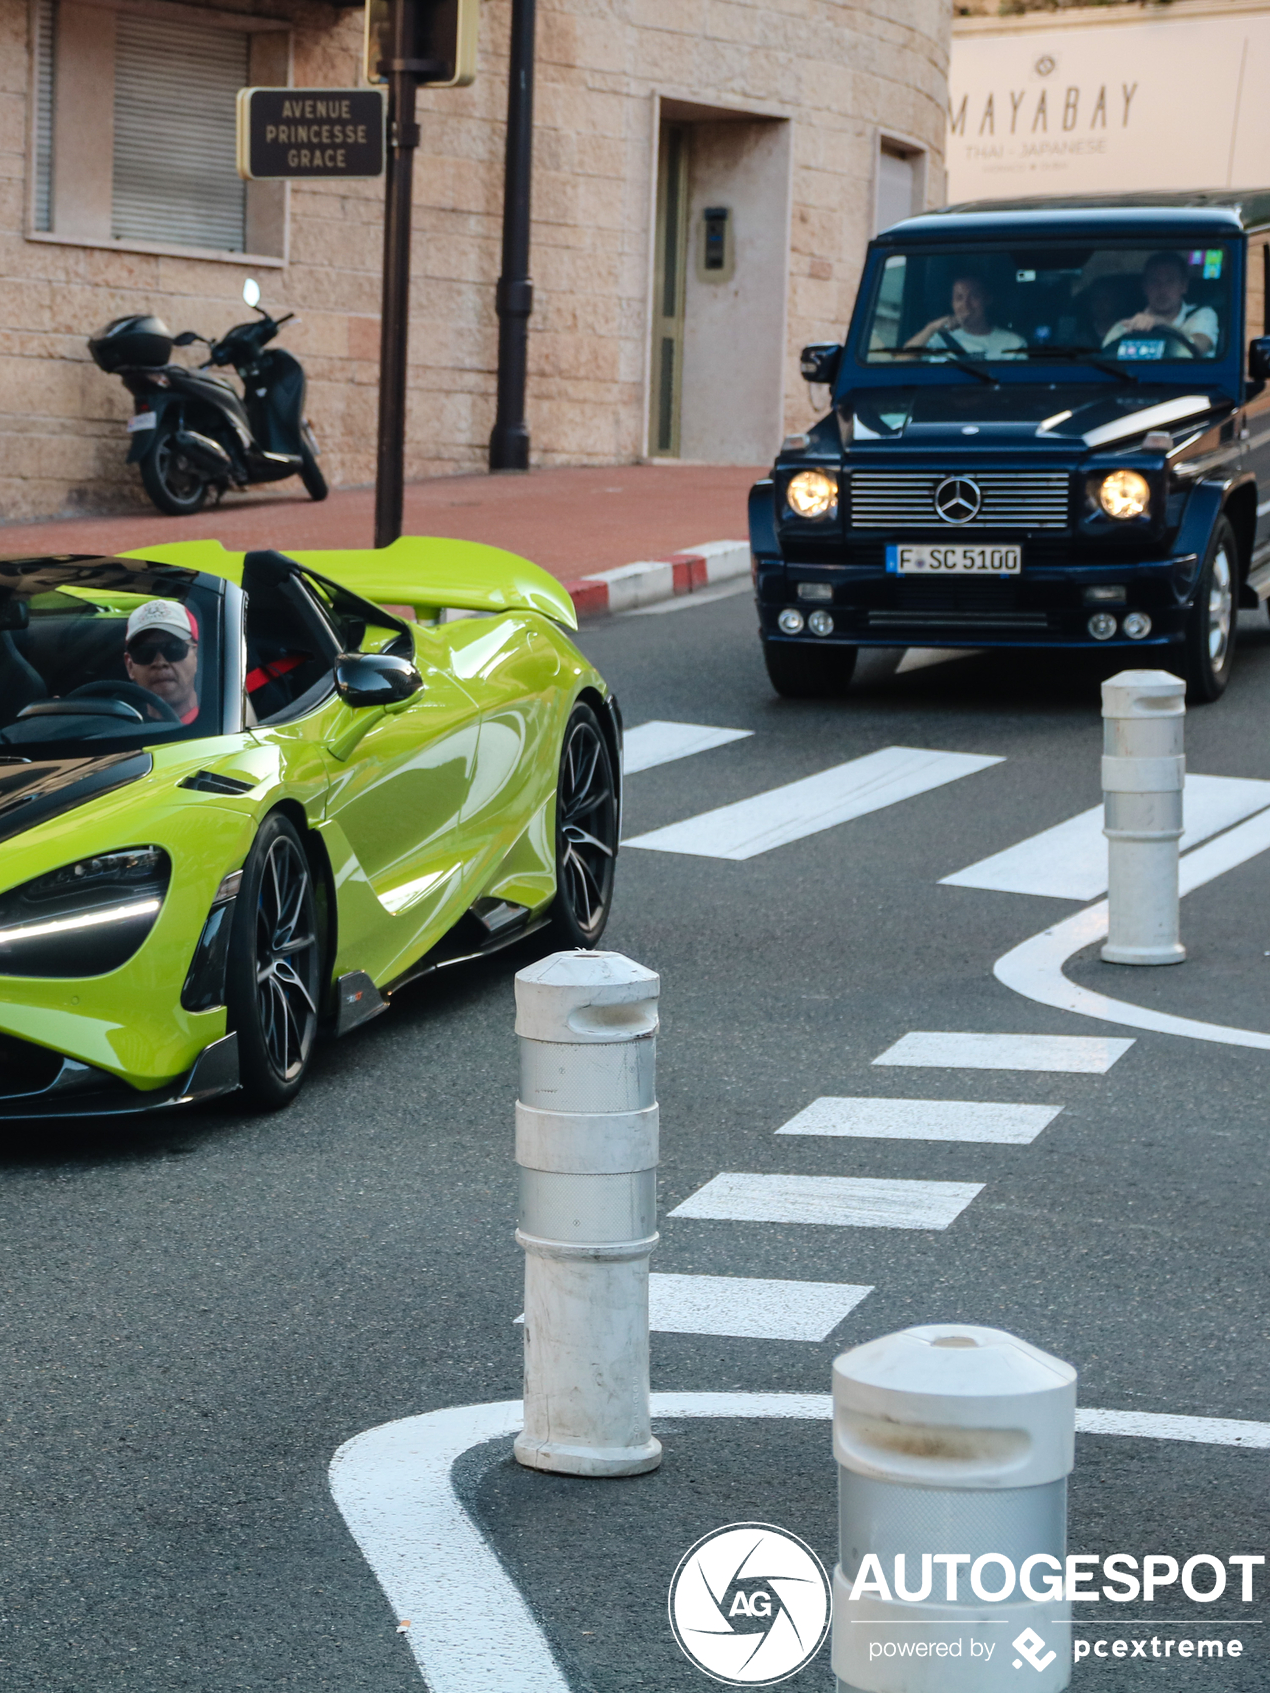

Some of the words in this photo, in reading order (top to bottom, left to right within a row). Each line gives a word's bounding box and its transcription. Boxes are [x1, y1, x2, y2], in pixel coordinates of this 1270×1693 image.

[282, 100, 351, 119] AVENUE
[948, 82, 1138, 137] MAYABAY
[266, 125, 368, 144] PRINCESSE
[288, 149, 347, 168] GRACE
[965, 143, 1004, 160] THAI
[1019, 137, 1108, 159] JAPANESE
[900, 549, 913, 570] F
[930, 549, 957, 570] SC
[963, 549, 1018, 570] 5100
